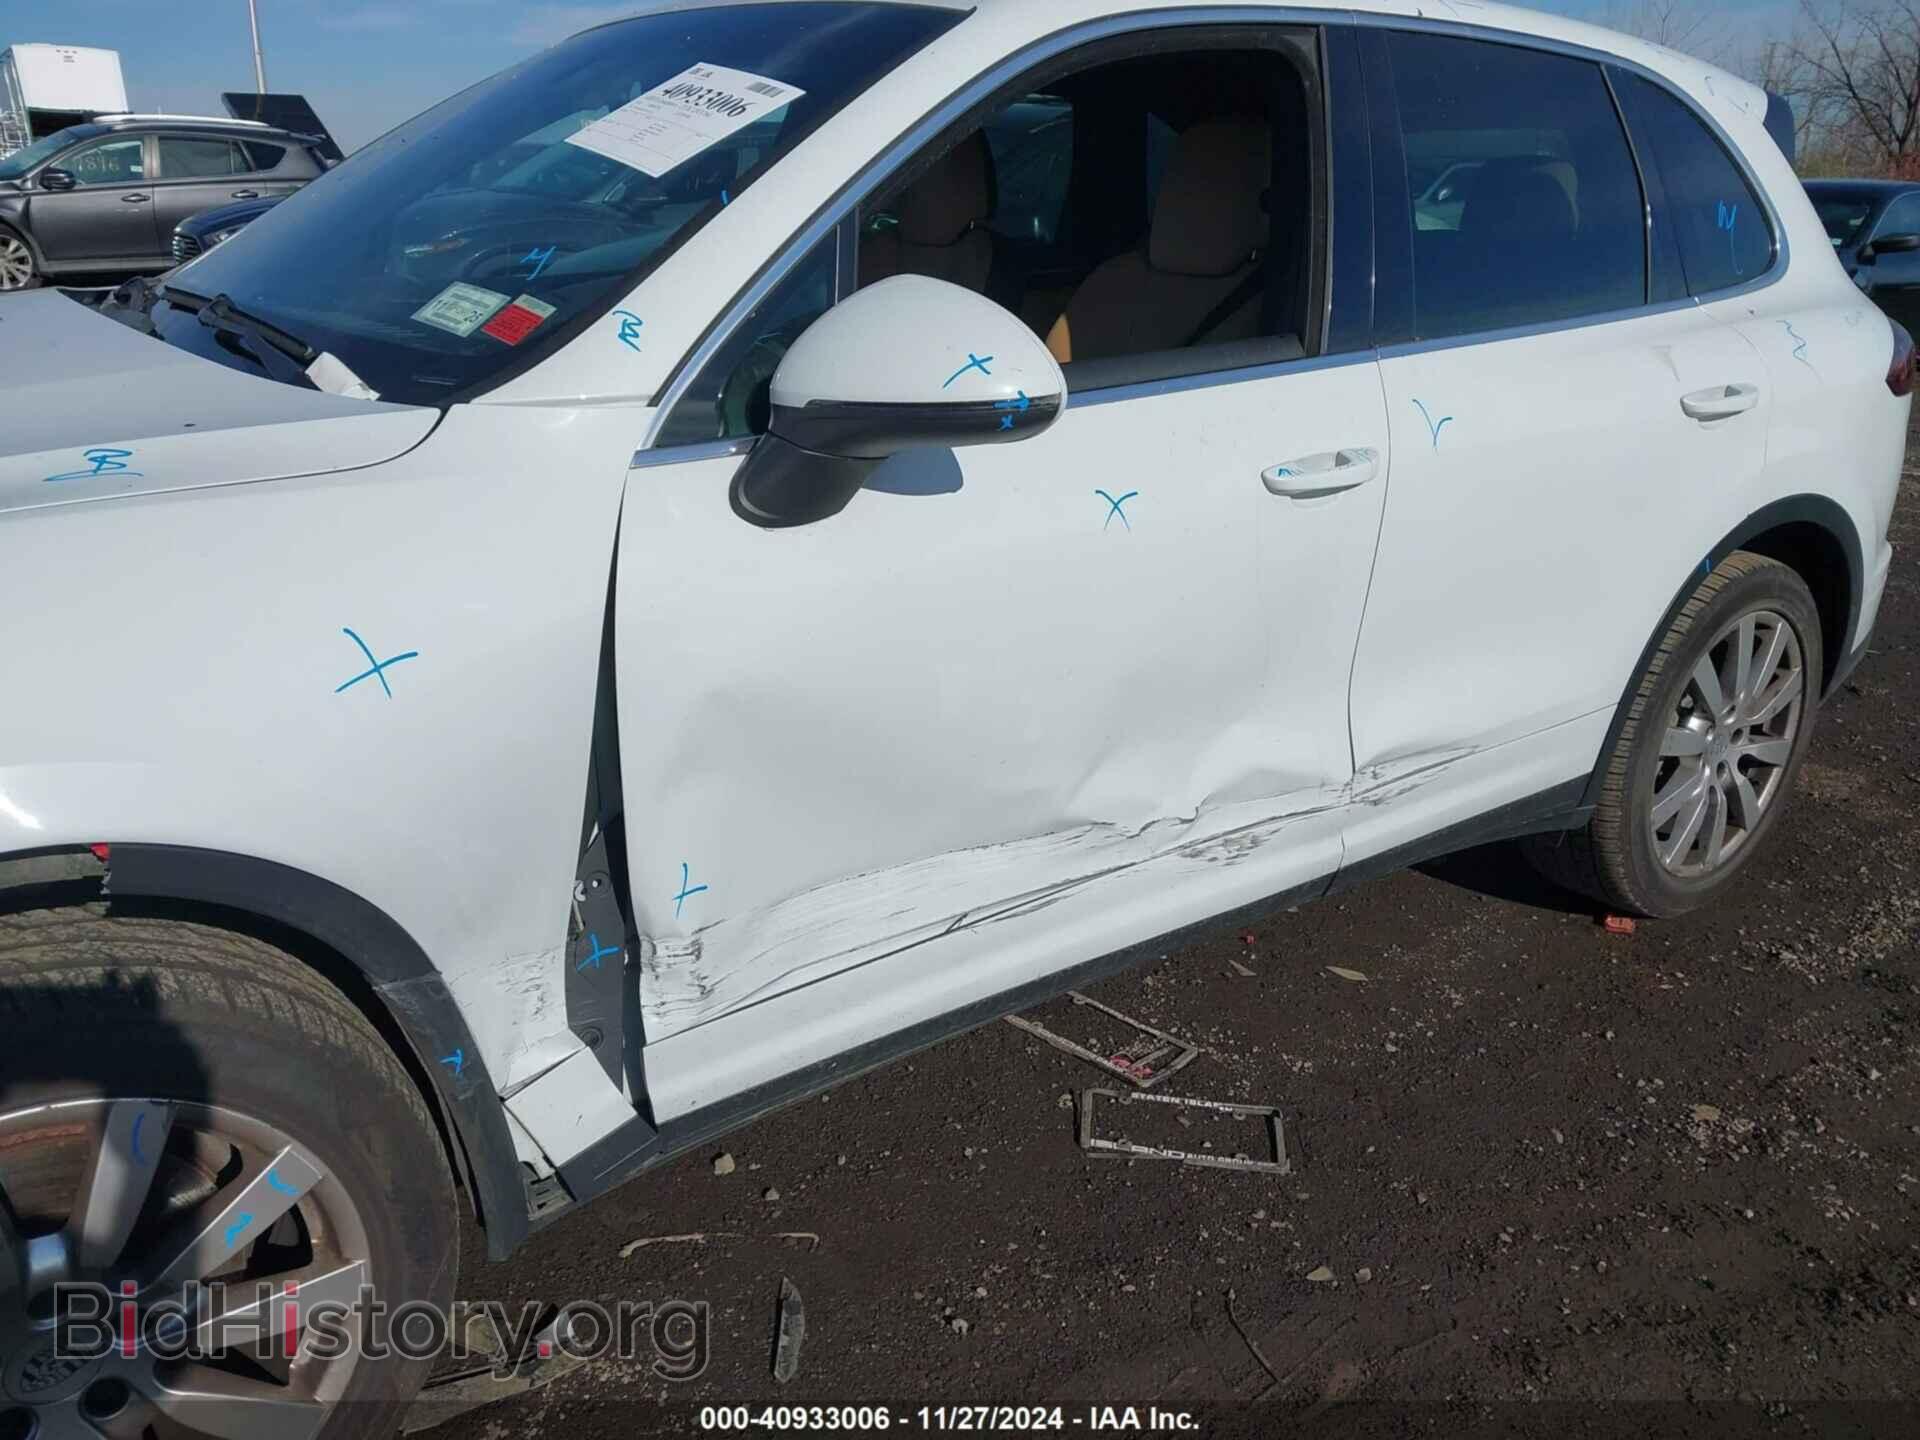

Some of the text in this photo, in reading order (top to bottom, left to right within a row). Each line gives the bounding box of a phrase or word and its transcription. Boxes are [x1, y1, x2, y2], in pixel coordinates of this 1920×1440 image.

[662, 82, 758, 118] 40933006
[1131, 1092, 1233, 1112] STATEN ISLAND
